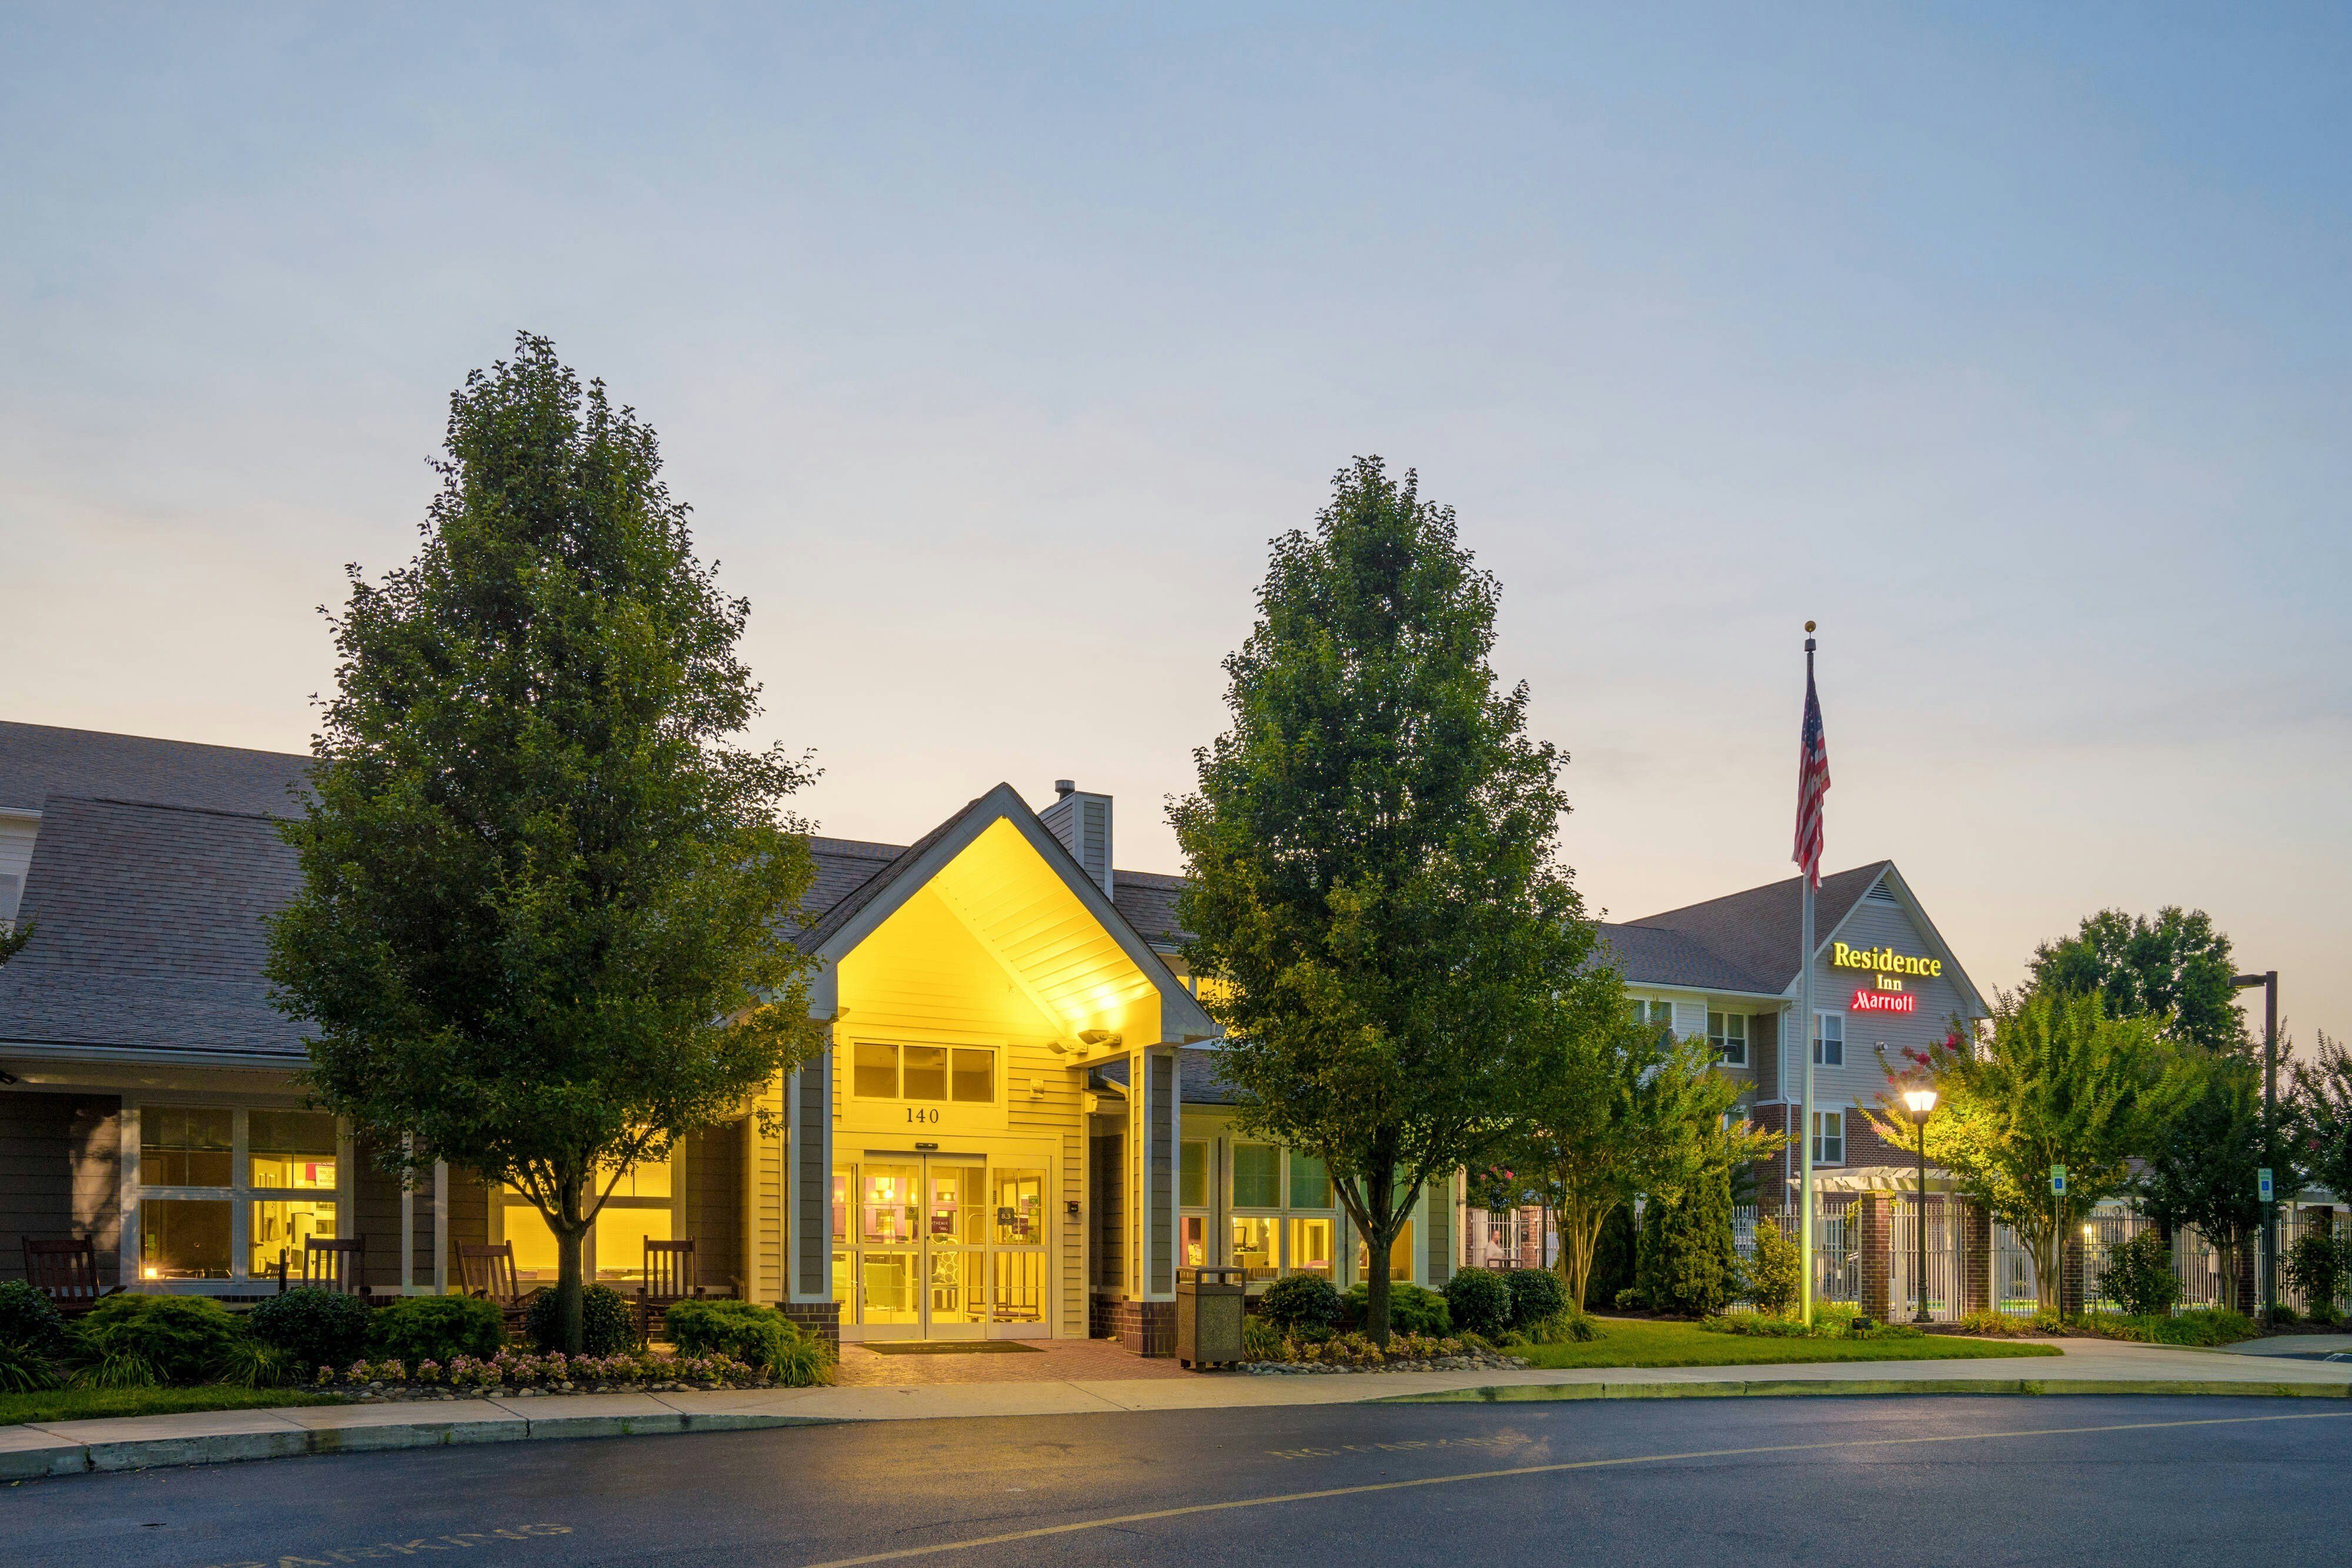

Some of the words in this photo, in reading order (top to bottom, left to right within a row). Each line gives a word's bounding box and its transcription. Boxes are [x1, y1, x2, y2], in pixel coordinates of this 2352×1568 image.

[1834, 942, 1941, 977] Residence
[1877, 974, 1902, 991] Inn
[1853, 991, 1913, 1011] Marriott
[907, 1108, 938, 1124] 140
